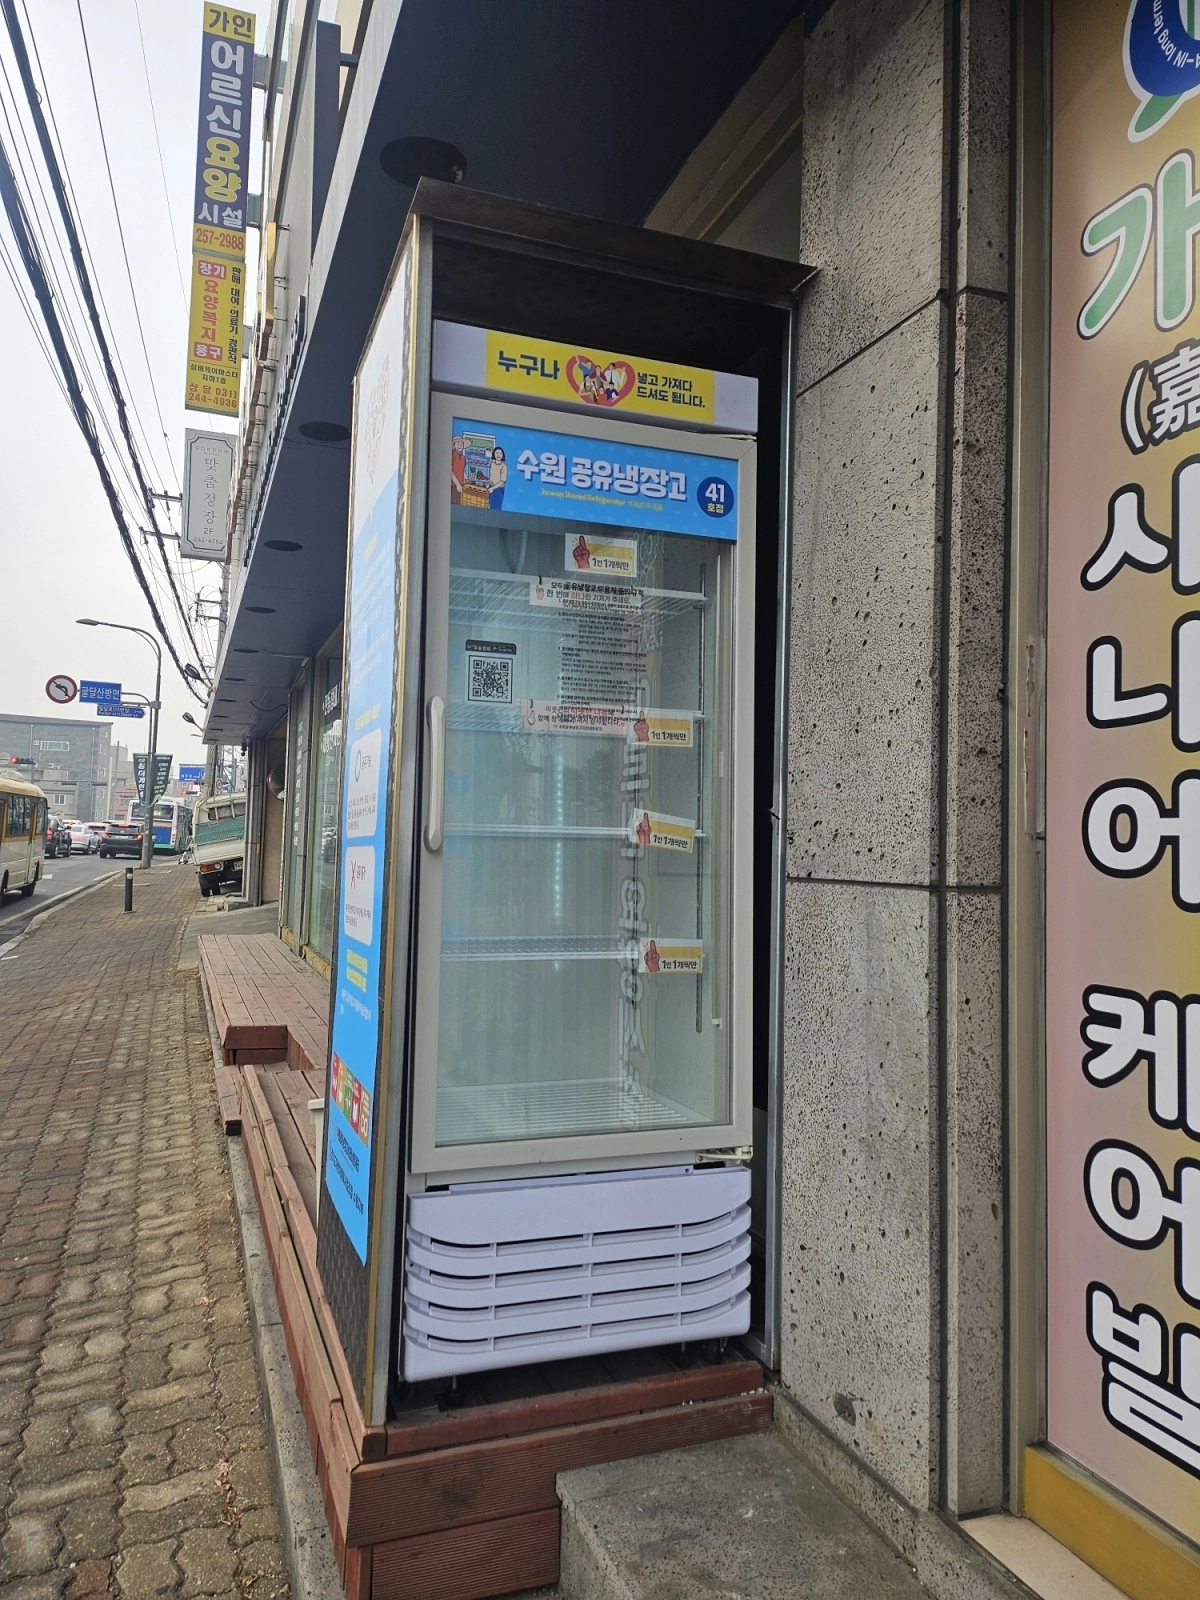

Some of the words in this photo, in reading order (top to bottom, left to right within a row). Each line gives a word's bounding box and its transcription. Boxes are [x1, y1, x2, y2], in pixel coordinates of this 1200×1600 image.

[209, 8, 252, 39] 가인
[1157, 28, 1177, 62] long
[198, 202, 243, 229] 시설
[195, 227, 244, 251] 257-2988
[1077, 149, 1200, 340] 가
[199, 261, 226, 279] 장기
[200, 279, 219, 342] 요양복지
[195, 344, 222, 360] 용구
[498, 350, 560, 380] 누구나
[202, 374, 226, 384] 지하1층
[638, 372, 658, 386] 넣고
[662, 376, 693, 392] 가져다
[188, 392, 237, 408] 244-4936
[637, 386, 668, 402] 드셔도
[672, 392, 705, 408] 됩니다.
[517, 450, 566, 485] 수원
[571, 456, 688, 501] 공유냉장고
[203, 457, 219, 525] 맞춤정장
[541, 488, 563, 497] Suwon
[565, 491, 586, 501] Shared
[587, 494, 626, 505] Refrigerator
[705, 483, 725, 503] 41
[707, 503, 724, 513] 호점
[203, 527, 214, 535] 2F
[592, 557, 602, 567] 1인
[603, 558, 629, 570] 1개씩만
[546, 589, 553, 597] 한
[651, 730, 661, 740] 1인
[662, 731, 686, 741] 1개씩만
[653, 834, 662, 843] 1인
[664, 836, 688, 848] 1개씩만
[662, 960, 671, 969] 1인
[673, 960, 697, 969] 1개씩만
